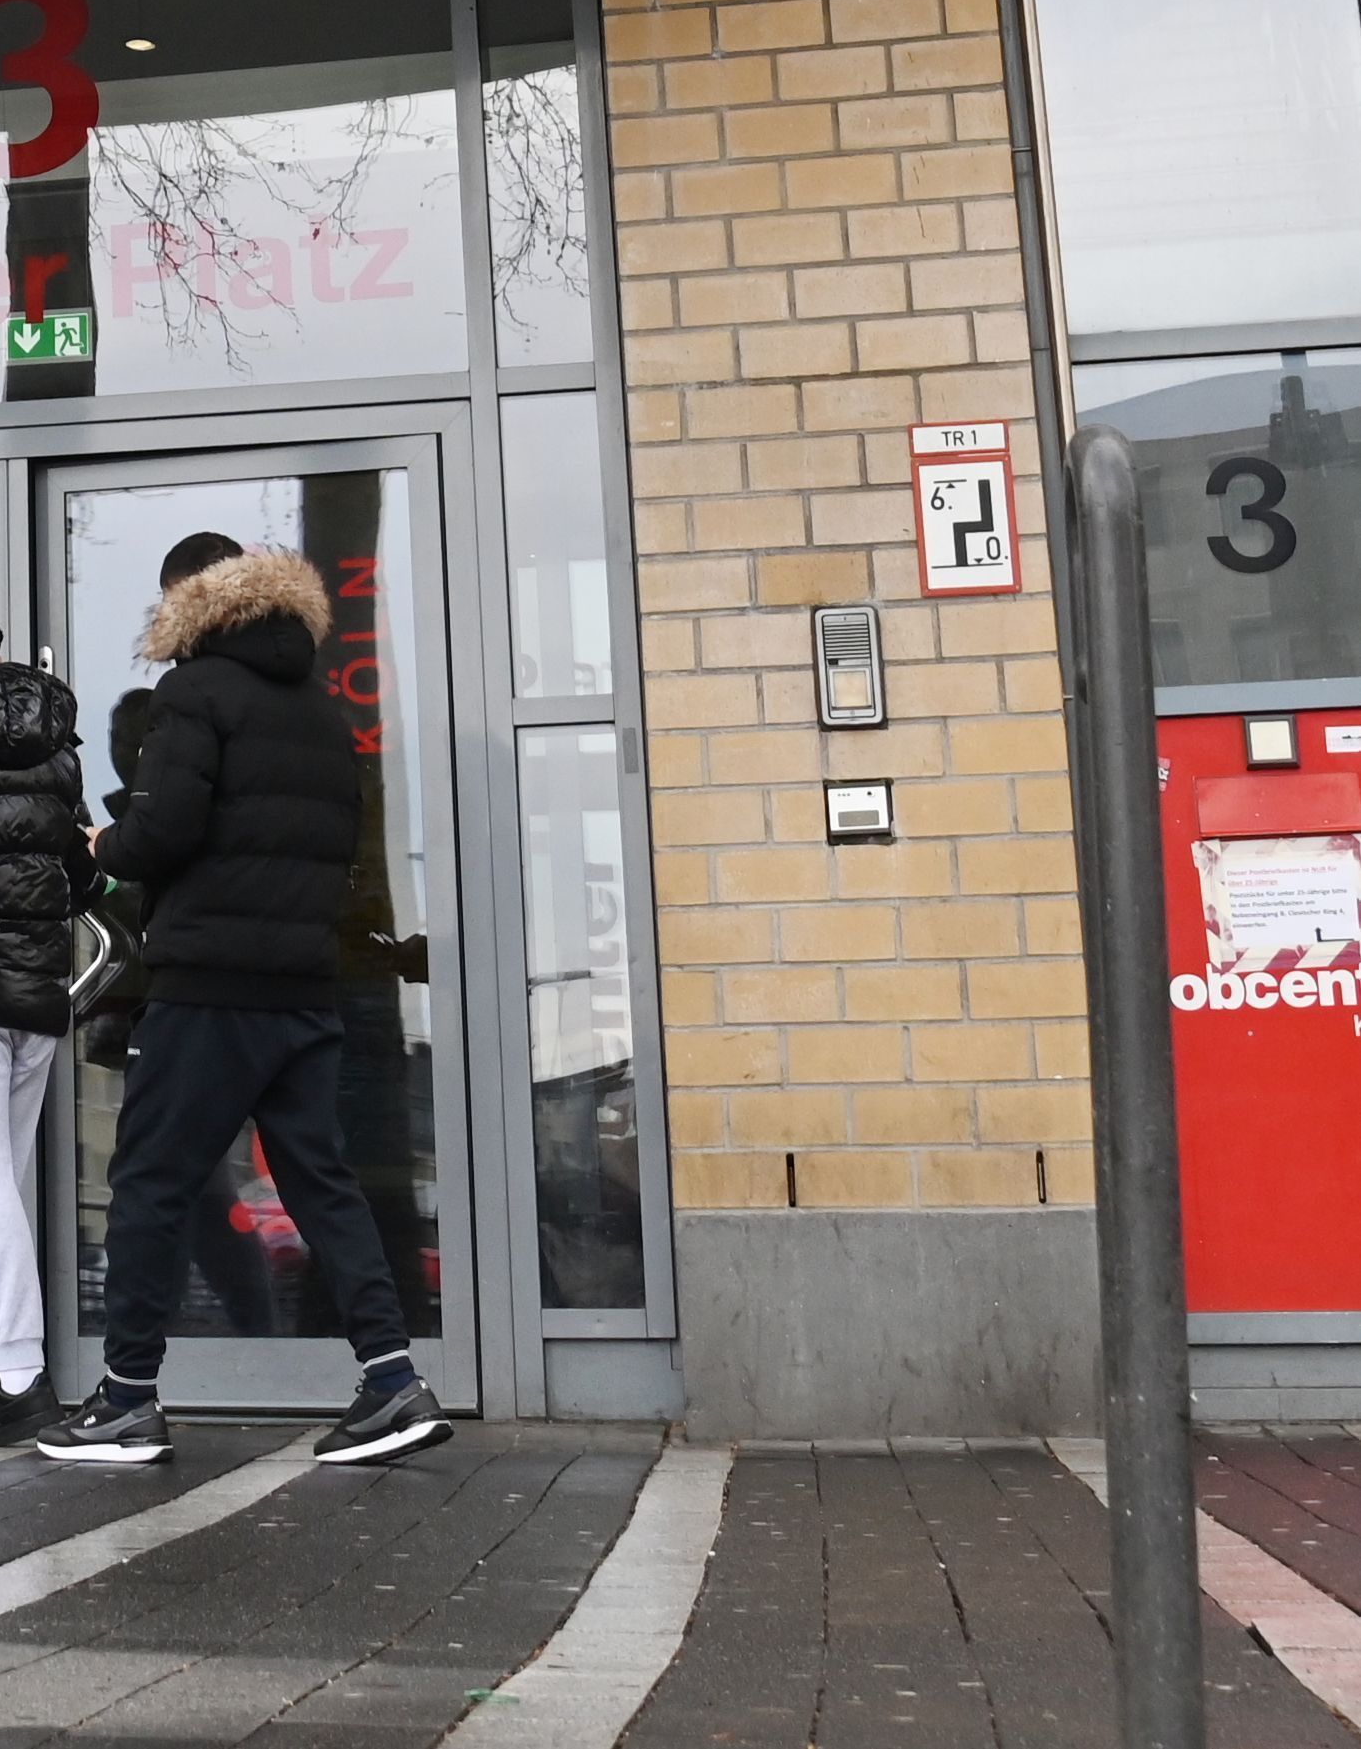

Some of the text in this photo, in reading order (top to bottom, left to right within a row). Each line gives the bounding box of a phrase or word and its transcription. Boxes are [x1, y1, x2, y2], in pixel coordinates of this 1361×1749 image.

[110, 212, 414, 318] Platz
[941, 429, 978, 447] TR 1
[1205, 456, 1298, 574] 3
[328, 556, 393, 754] KÖLN
[1169, 962, 1361, 1012] obcen
